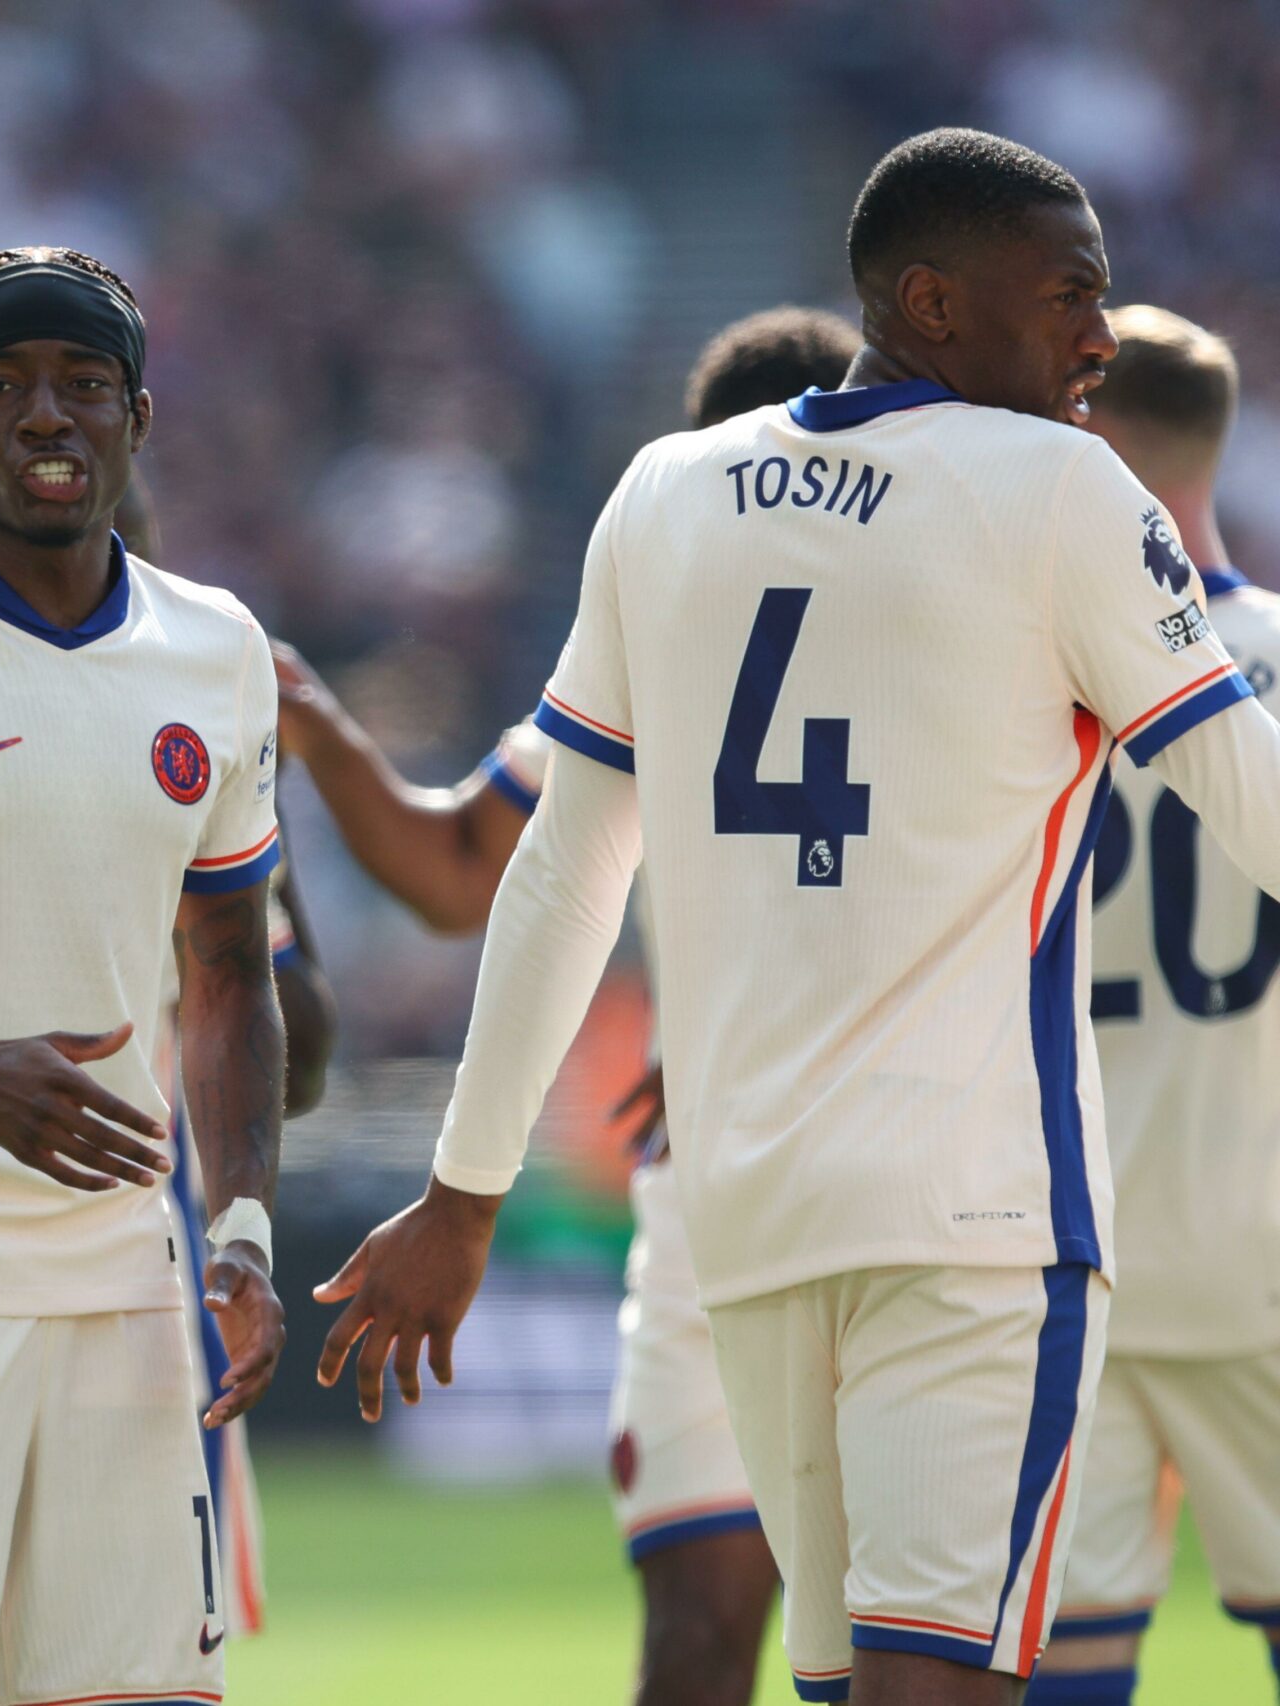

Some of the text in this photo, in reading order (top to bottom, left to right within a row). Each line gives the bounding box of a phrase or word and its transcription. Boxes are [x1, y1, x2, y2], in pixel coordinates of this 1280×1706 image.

[726, 456, 893, 526] TOSIN
[1156, 617, 1184, 639] No
[713, 587, 871, 886] 4
[192, 1495, 215, 1614] 1
